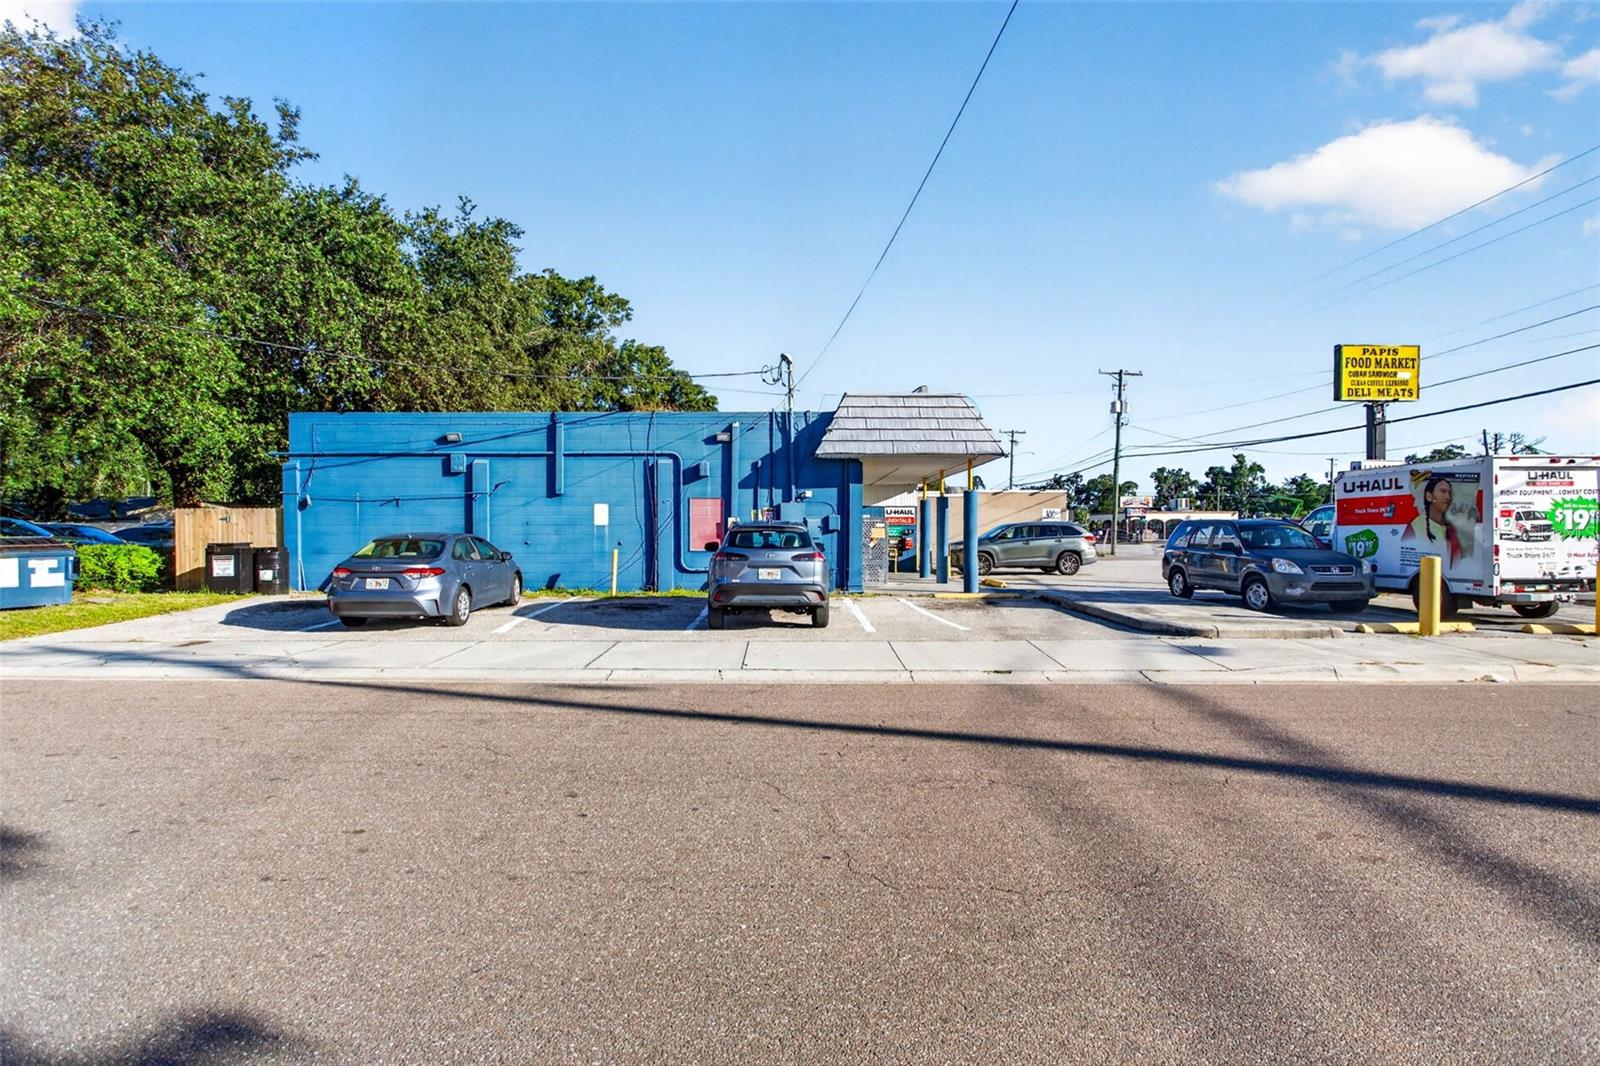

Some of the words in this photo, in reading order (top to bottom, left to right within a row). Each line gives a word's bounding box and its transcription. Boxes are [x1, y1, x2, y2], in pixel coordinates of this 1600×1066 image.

[1362, 348, 1399, 356] PAPIS
[1345, 357, 1372, 368] FOOD
[1374, 357, 1417, 369] MARKET
[1347, 388, 1371, 397] DELI
[1377, 388, 1413, 397] MEATS
[1527, 471, 1573, 480] U-HAUL
[1343, 477, 1404, 493] U-HAUL
